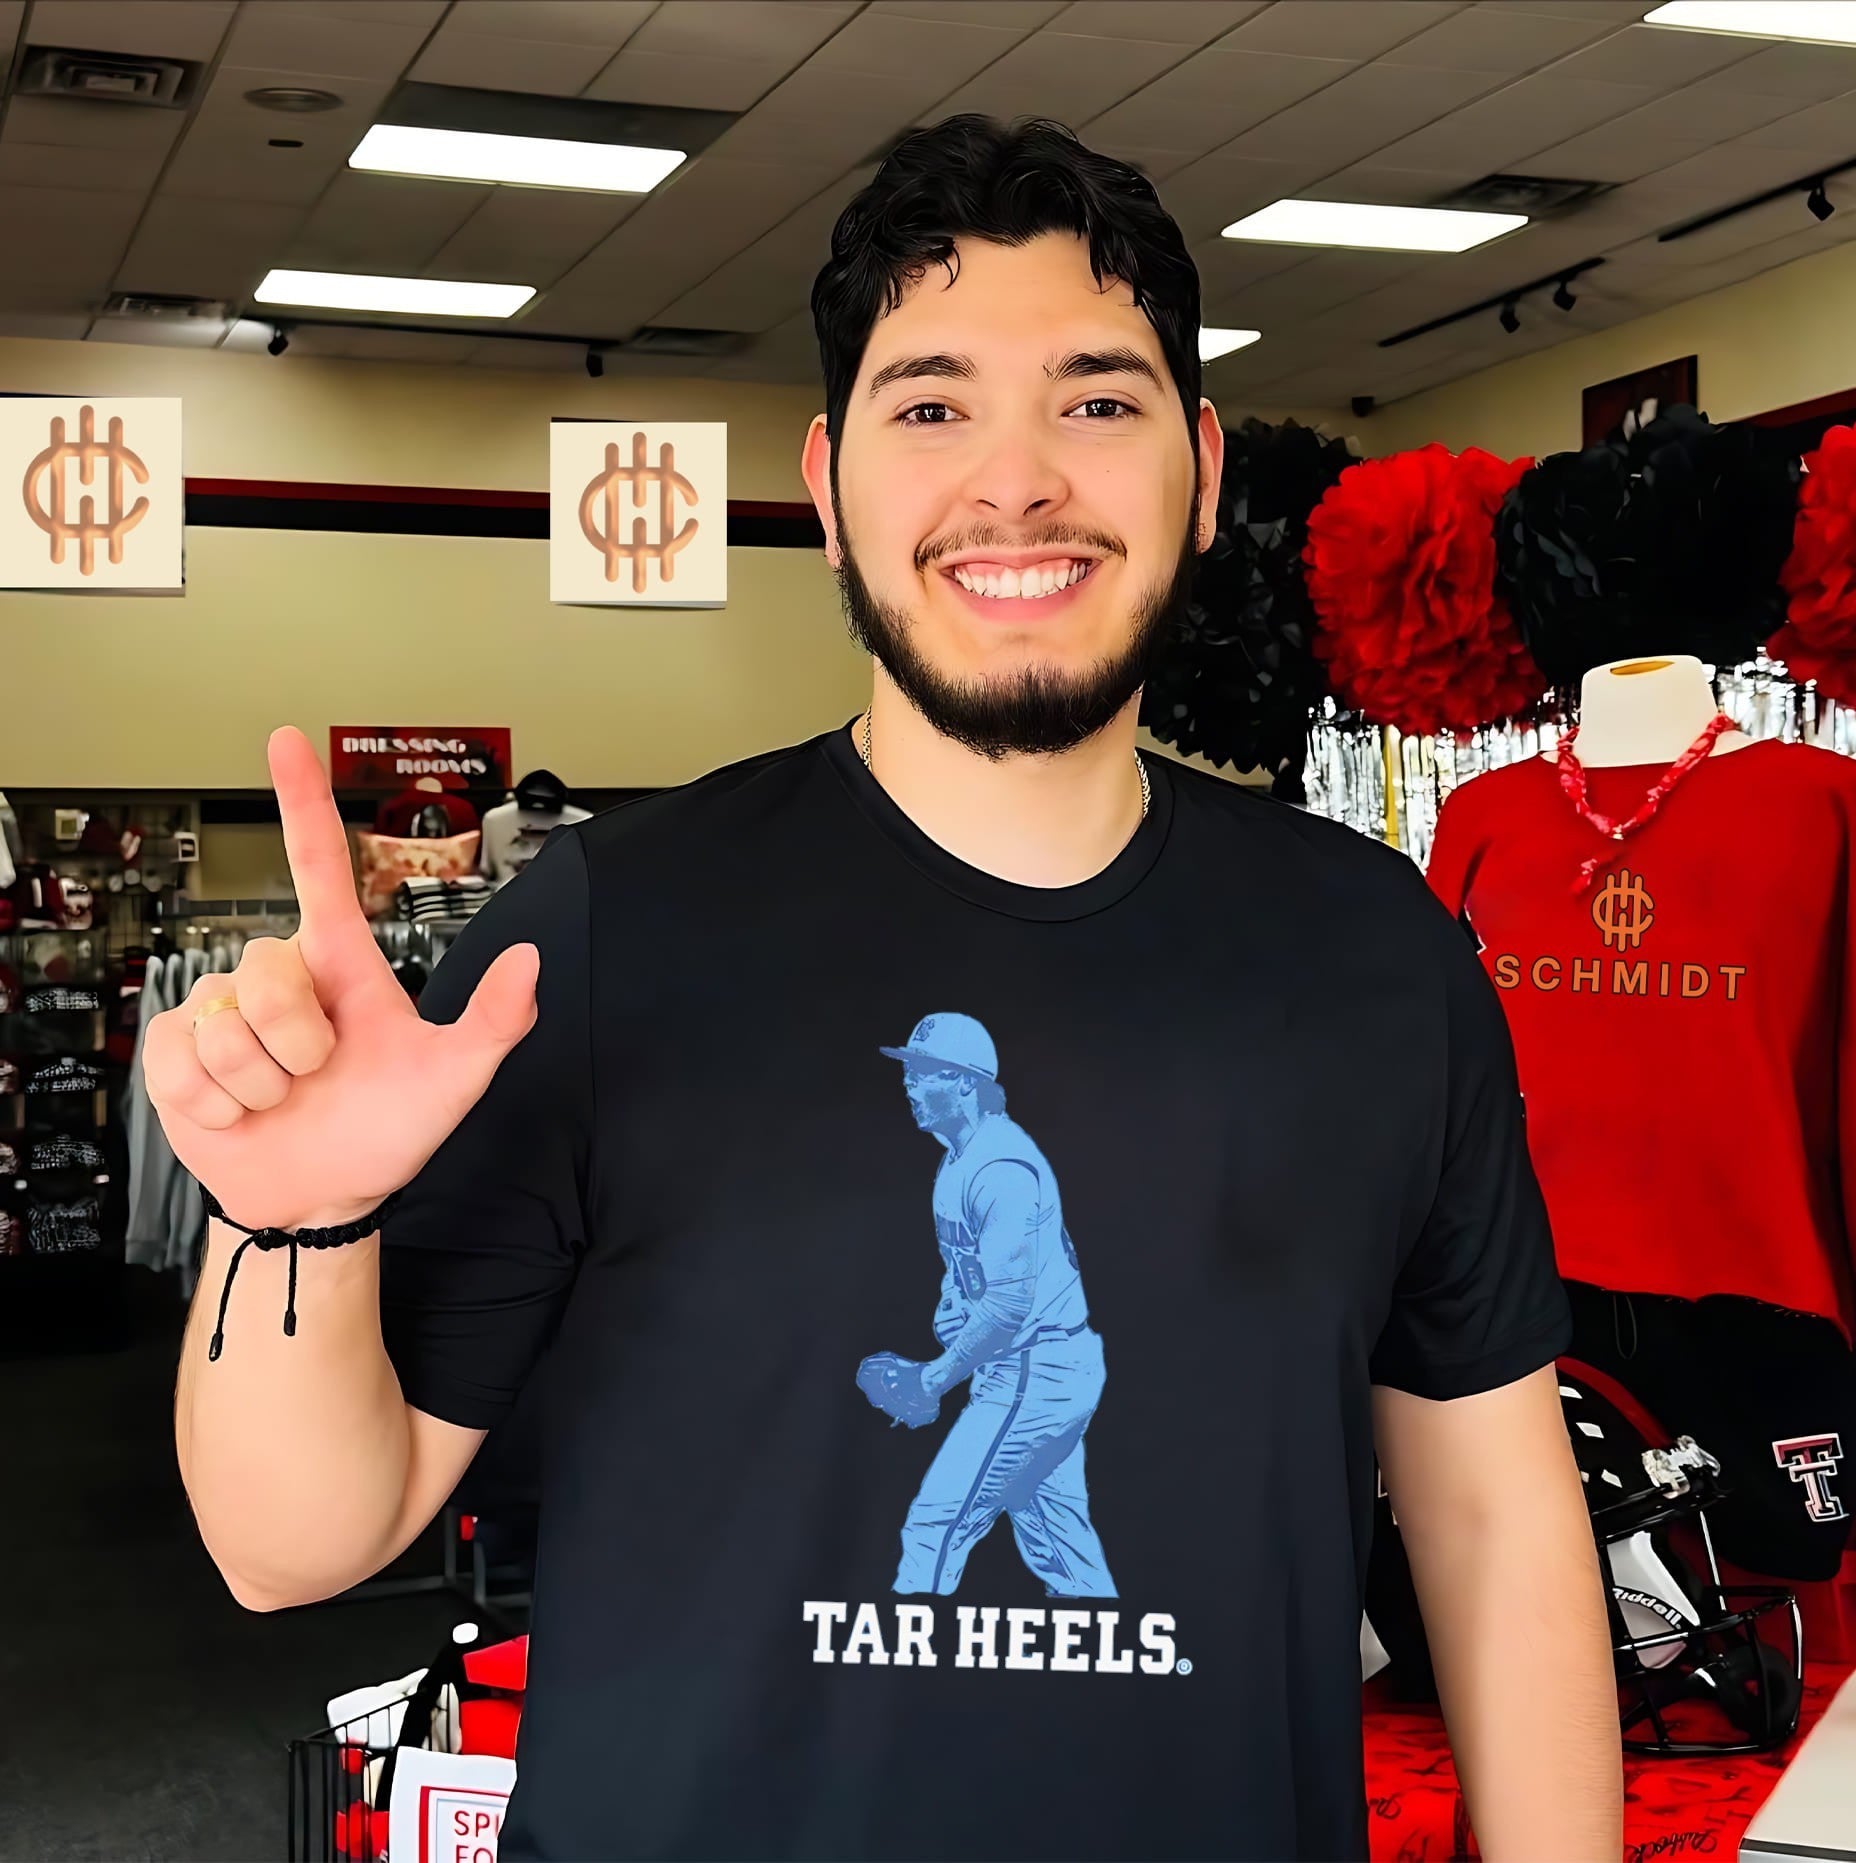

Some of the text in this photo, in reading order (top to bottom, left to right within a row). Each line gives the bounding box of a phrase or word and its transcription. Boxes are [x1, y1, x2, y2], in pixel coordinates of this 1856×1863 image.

[342, 737, 467, 754] DRESSING
[396, 758, 487, 775] ROOMS
[1494, 953, 1746, 1000] SCHMIDT
[803, 1600, 938, 1667] TAR
